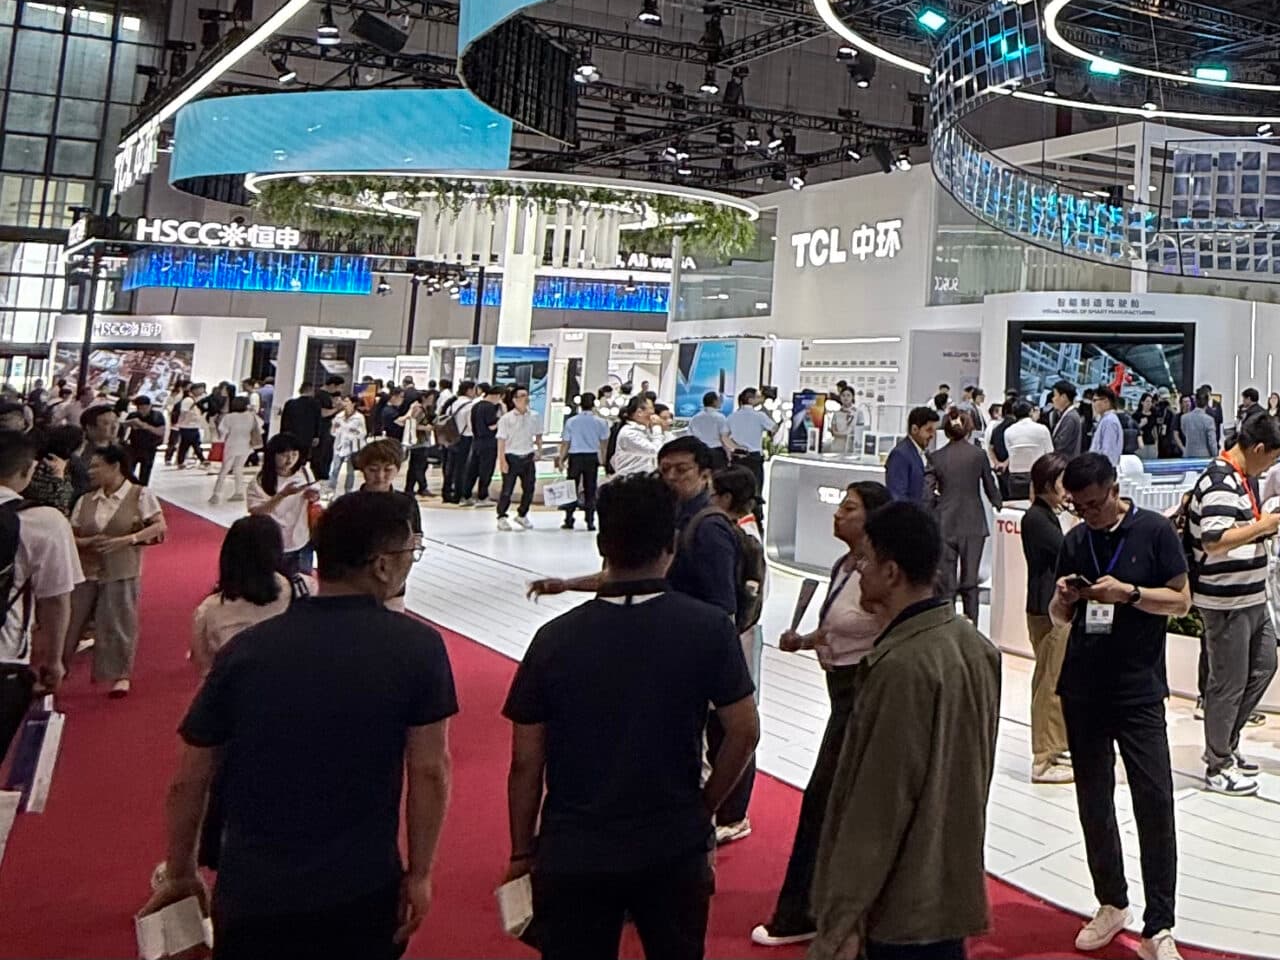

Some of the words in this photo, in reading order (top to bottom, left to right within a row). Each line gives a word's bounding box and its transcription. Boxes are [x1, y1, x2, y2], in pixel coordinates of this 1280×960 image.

[136, 217, 221, 248] HSCC
[246, 223, 300, 249] 恒申
[791, 227, 847, 268] TCL
[851, 219, 902, 262] 中环
[997, 519, 1021, 535] TCL
